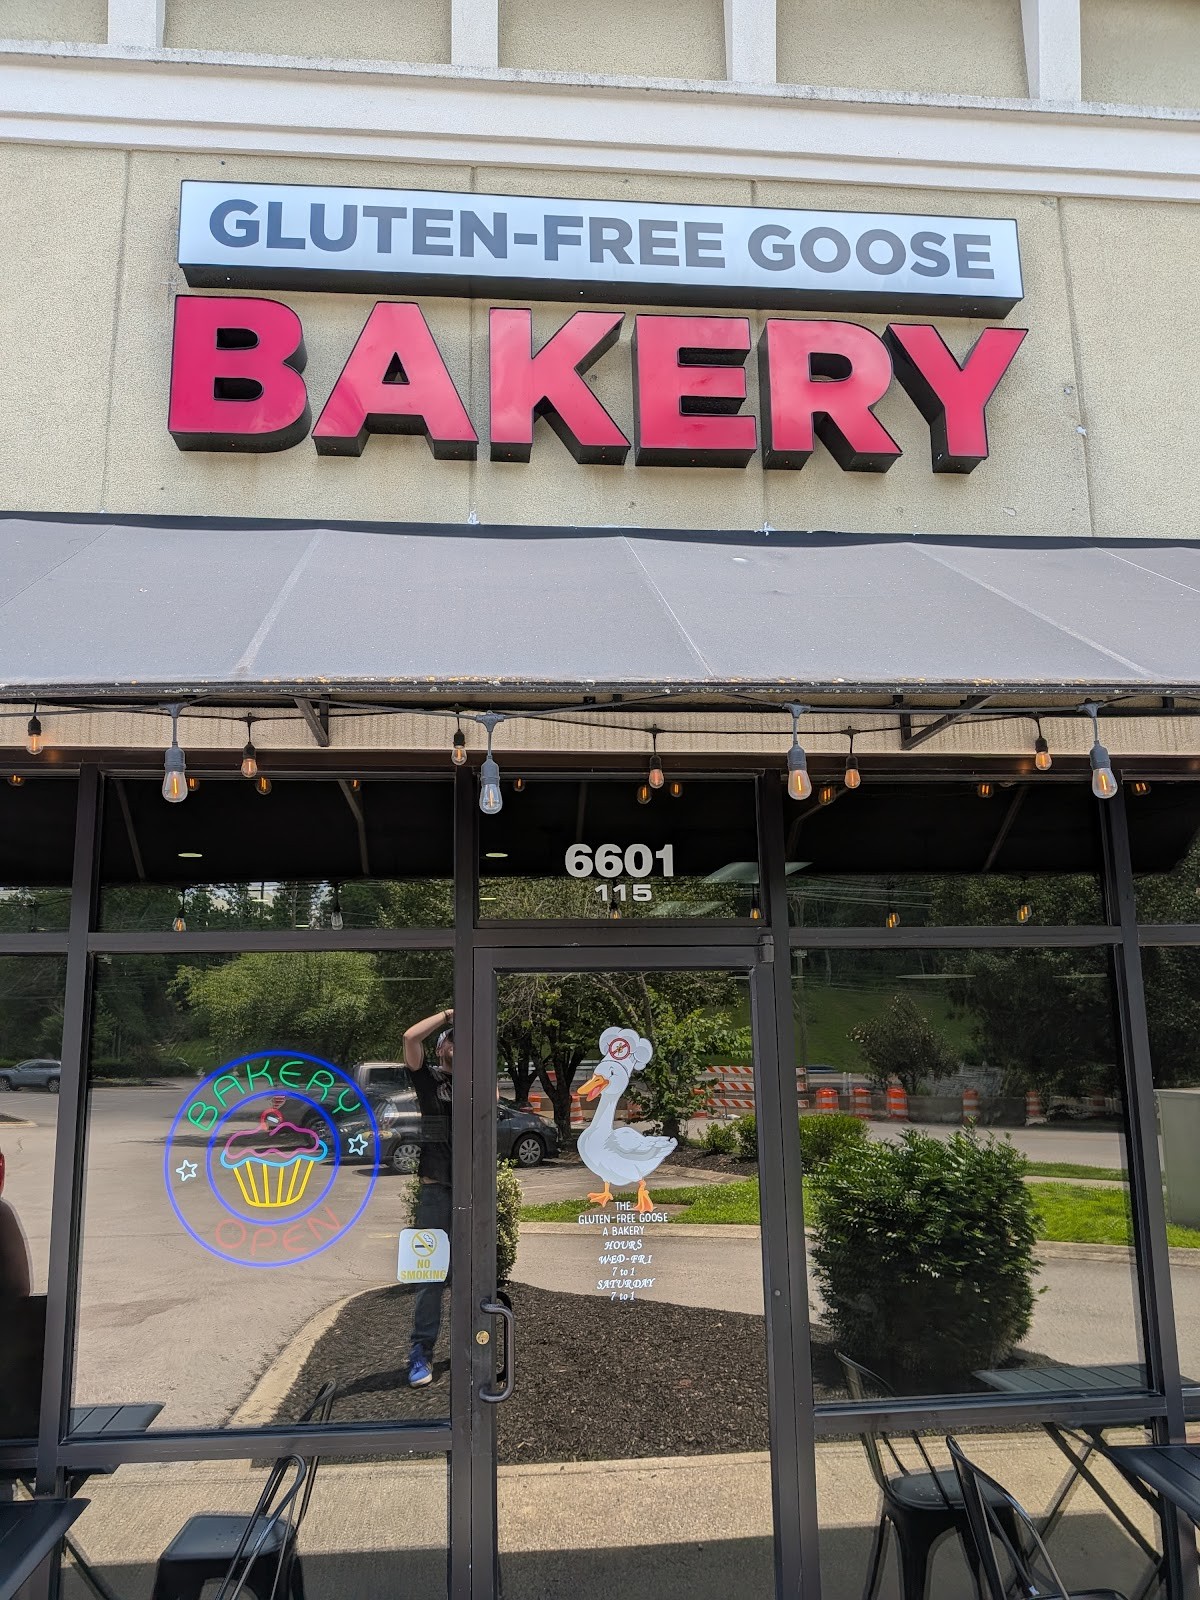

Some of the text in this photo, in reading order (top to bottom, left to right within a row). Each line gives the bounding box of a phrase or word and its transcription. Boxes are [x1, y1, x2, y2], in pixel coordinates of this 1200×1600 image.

[209, 198, 996, 280] GLUTEN-FREE GOOSE
[168, 294, 1029, 463] BAKERY
[565, 843, 675, 878] 6601
[595, 884, 652, 902] 115
[187, 1059, 361, 1131] BAKERY
[615, 1201, 631, 1211] THE
[578, 1212, 668, 1224] GLUTEN-FREE GOOSE
[215, 1206, 342, 1256] OPEN
[602, 1226, 645, 1236] A BAKERY
[604, 1239, 642, 1250] HOURS
[417, 1259, 431, 1269] NO
[400, 1270, 447, 1280] SMOKING
[612, 1267, 635, 1276] 7 to 1
[596, 1278, 656, 1289] SATURDAY
[610, 1291, 635, 1301] 7 to 1
